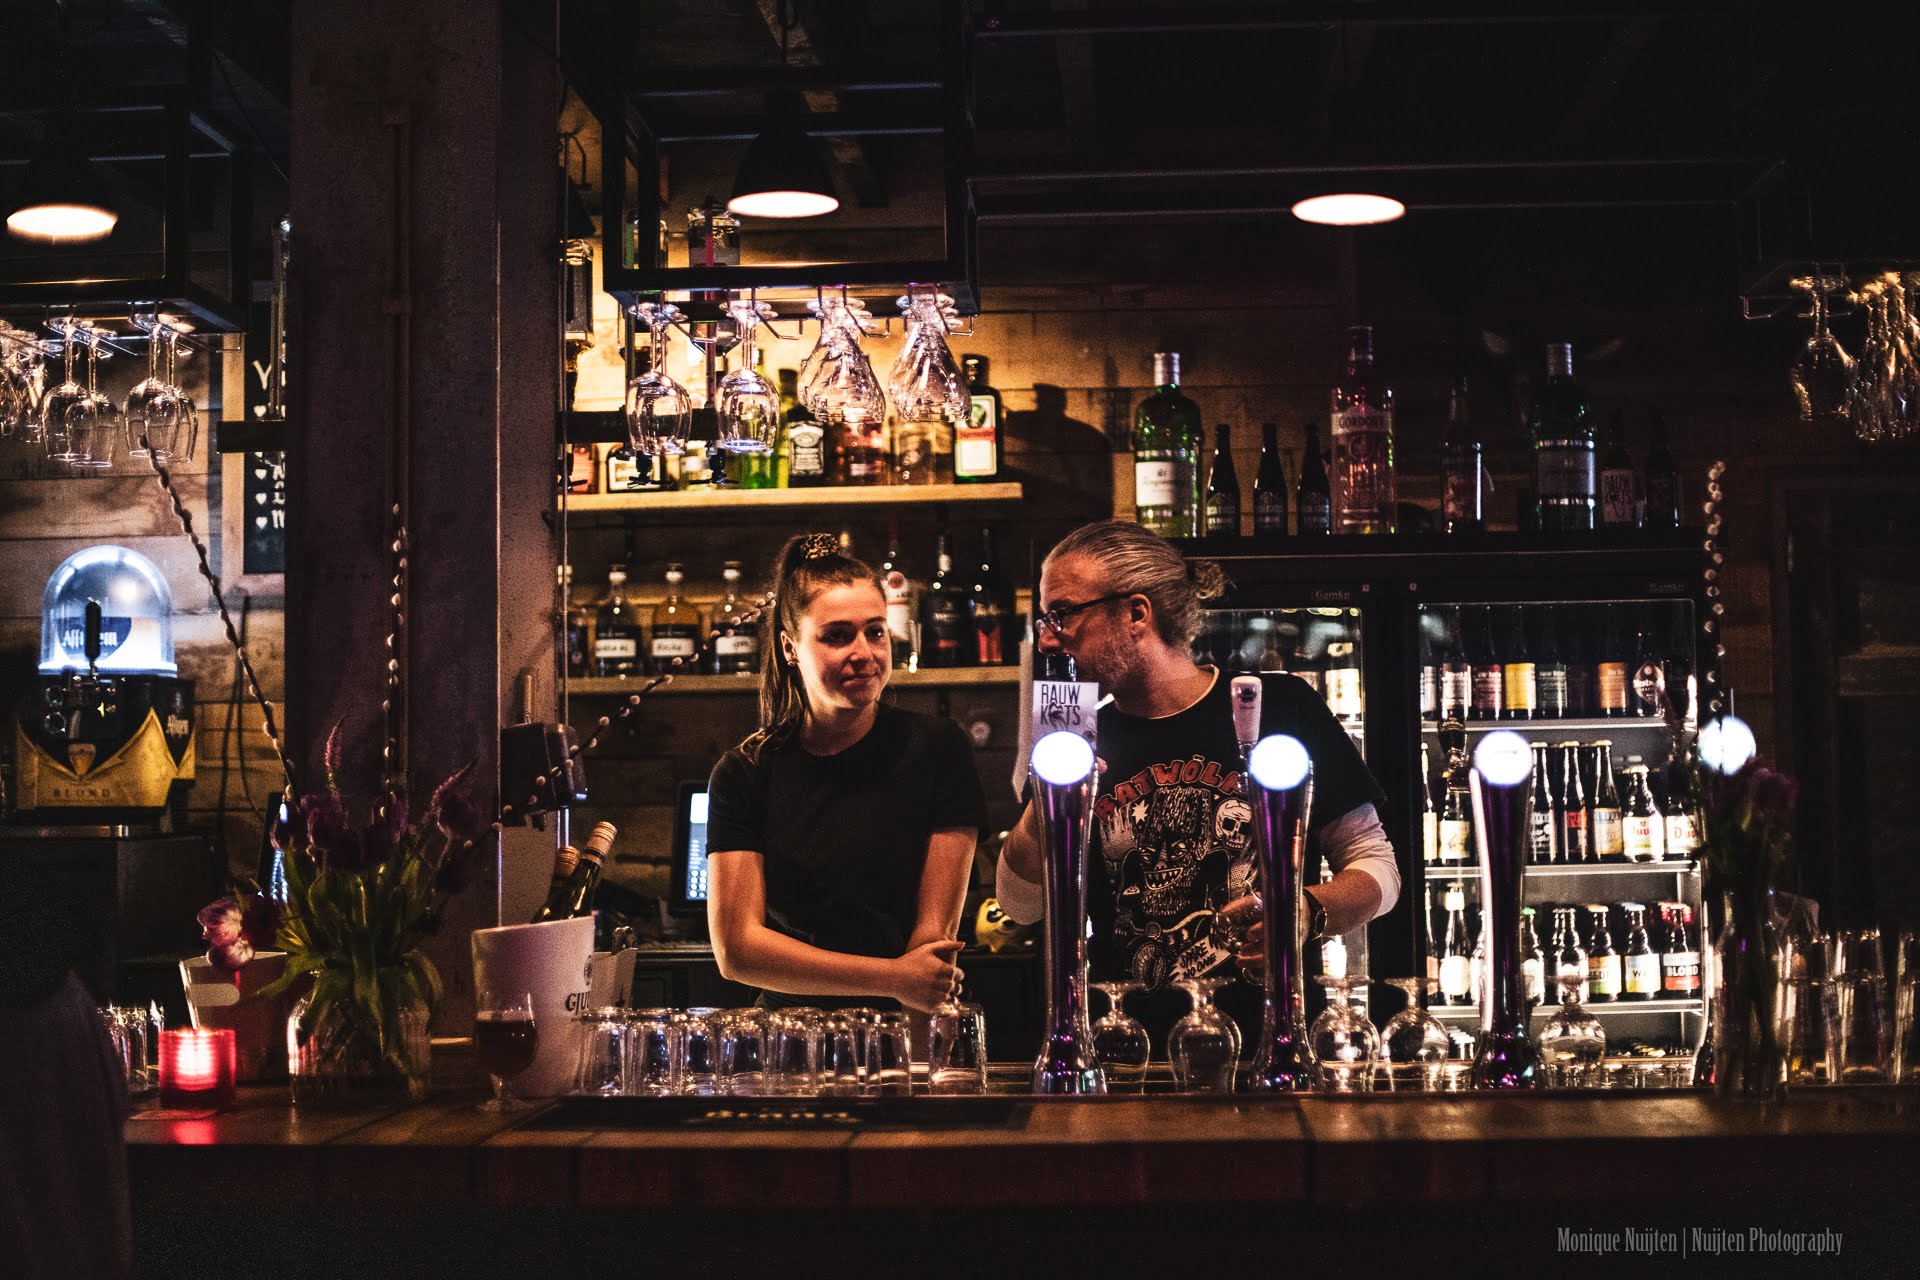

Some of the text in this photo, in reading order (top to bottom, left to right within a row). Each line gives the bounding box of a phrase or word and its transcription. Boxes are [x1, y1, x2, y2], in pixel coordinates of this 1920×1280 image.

[1315, 590, 1350, 600] Gamko
[1041, 684, 1080, 704] RAUW
[1180, 941, 1209, 969] SPARE
[1184, 953, 1217, 979] NO ONE
[1666, 965, 1699, 977] BLOND
